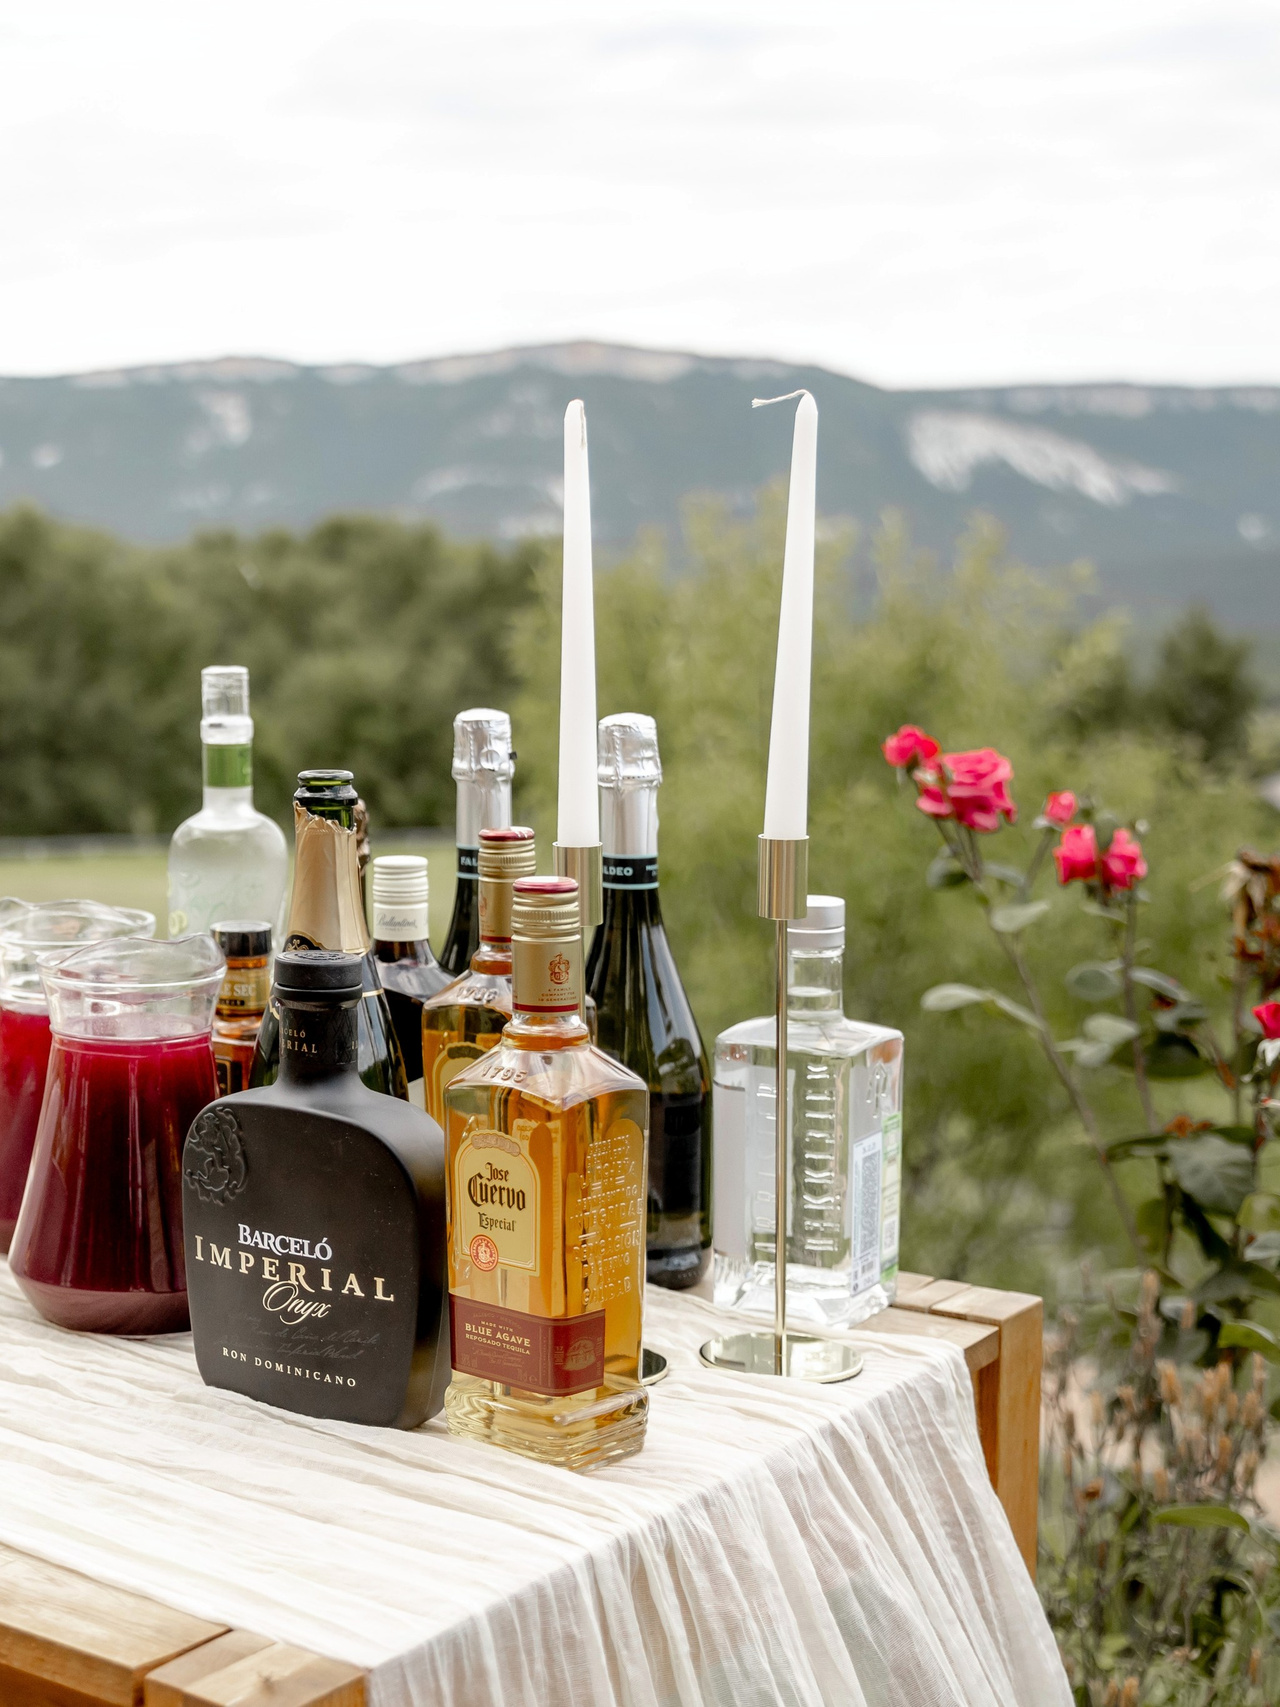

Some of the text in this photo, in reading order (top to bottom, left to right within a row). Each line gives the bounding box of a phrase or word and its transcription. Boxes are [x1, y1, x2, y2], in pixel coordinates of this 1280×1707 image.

[460, 856, 479, 867] FAL
[603, 865, 633, 877] LDEO
[233, 983, 256, 997] SEC
[481, 1064, 528, 1083] 1795
[485, 1162, 510, 1182] Jose
[467, 1172, 526, 1212] Cuervo
[478, 1211, 516, 1232] Especial
[237, 1223, 333, 1261] BARCELÓ
[194, 1235, 395, 1302] IMPERIAL
[262, 1280, 332, 1325] Onyx
[465, 1322, 531, 1347] BLUE AGAVE
[480, 1320, 514, 1333] MADE WITH
[465, 1333, 531, 1355] REPOSADO TEQUILA
[222, 1347, 356, 1387] RON DOMINICANO
